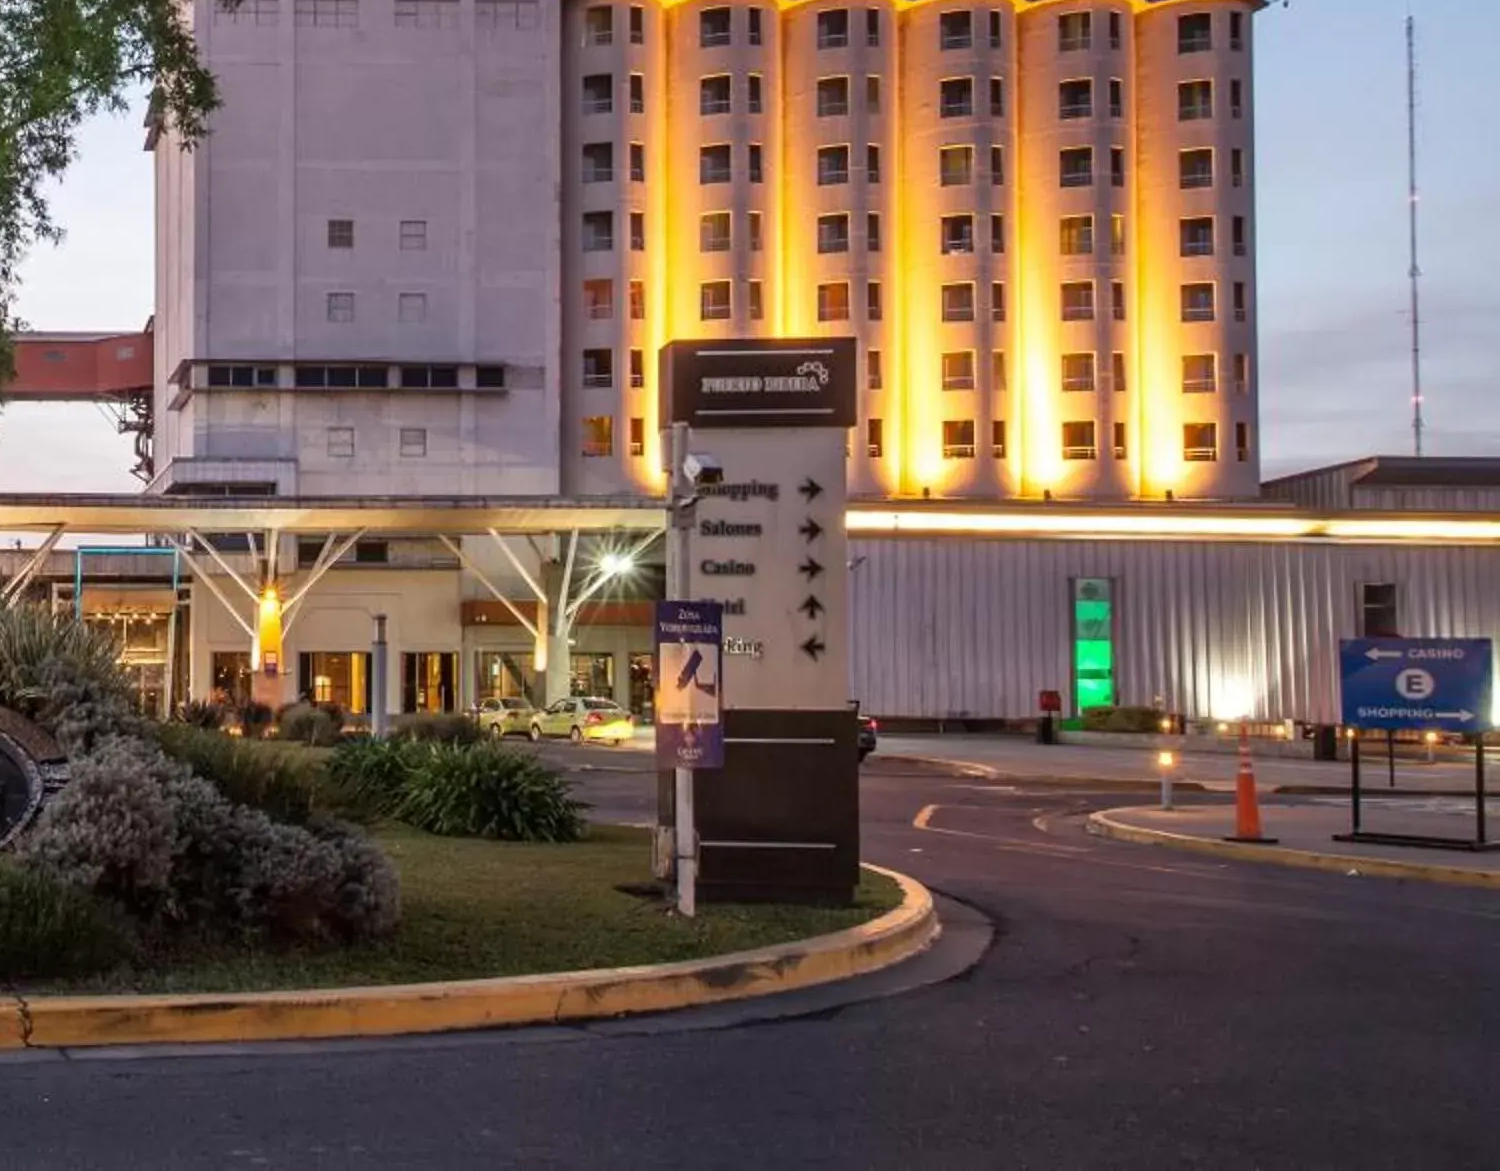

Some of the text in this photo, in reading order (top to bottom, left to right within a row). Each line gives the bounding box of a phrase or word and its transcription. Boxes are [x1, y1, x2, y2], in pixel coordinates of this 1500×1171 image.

[701, 559, 756, 576] Casino
[1408, 648, 1465, 659] CASINO
[1406, 675, 1424, 693] E
[1357, 706, 1434, 719] SHOPPING
